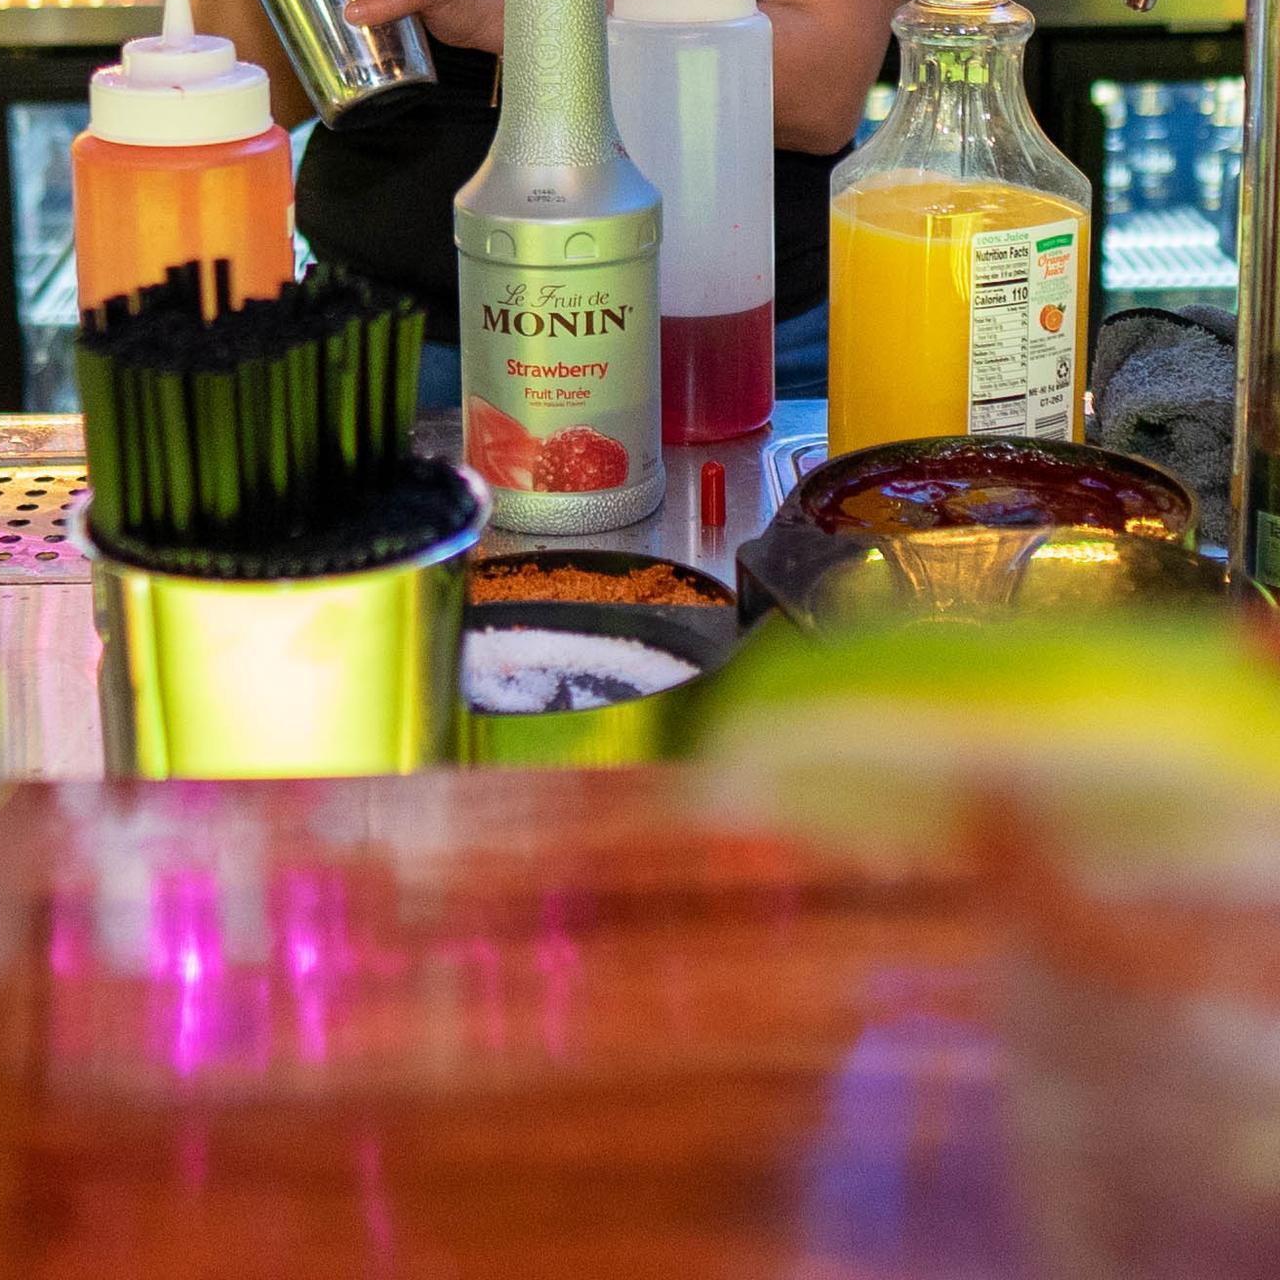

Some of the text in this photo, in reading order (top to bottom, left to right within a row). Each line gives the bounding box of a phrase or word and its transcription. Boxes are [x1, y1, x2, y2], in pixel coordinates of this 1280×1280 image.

[976, 246, 1029, 262] Nutrition Facts
[497, 283, 610, 309] Le Fruit de
[975, 293, 1007, 306] Calories
[1012, 287, 1029, 301] 110
[482, 304, 629, 338] MONIN
[506, 358, 609, 380] Strawberry
[524, 387, 591, 400] Fruit Purée
